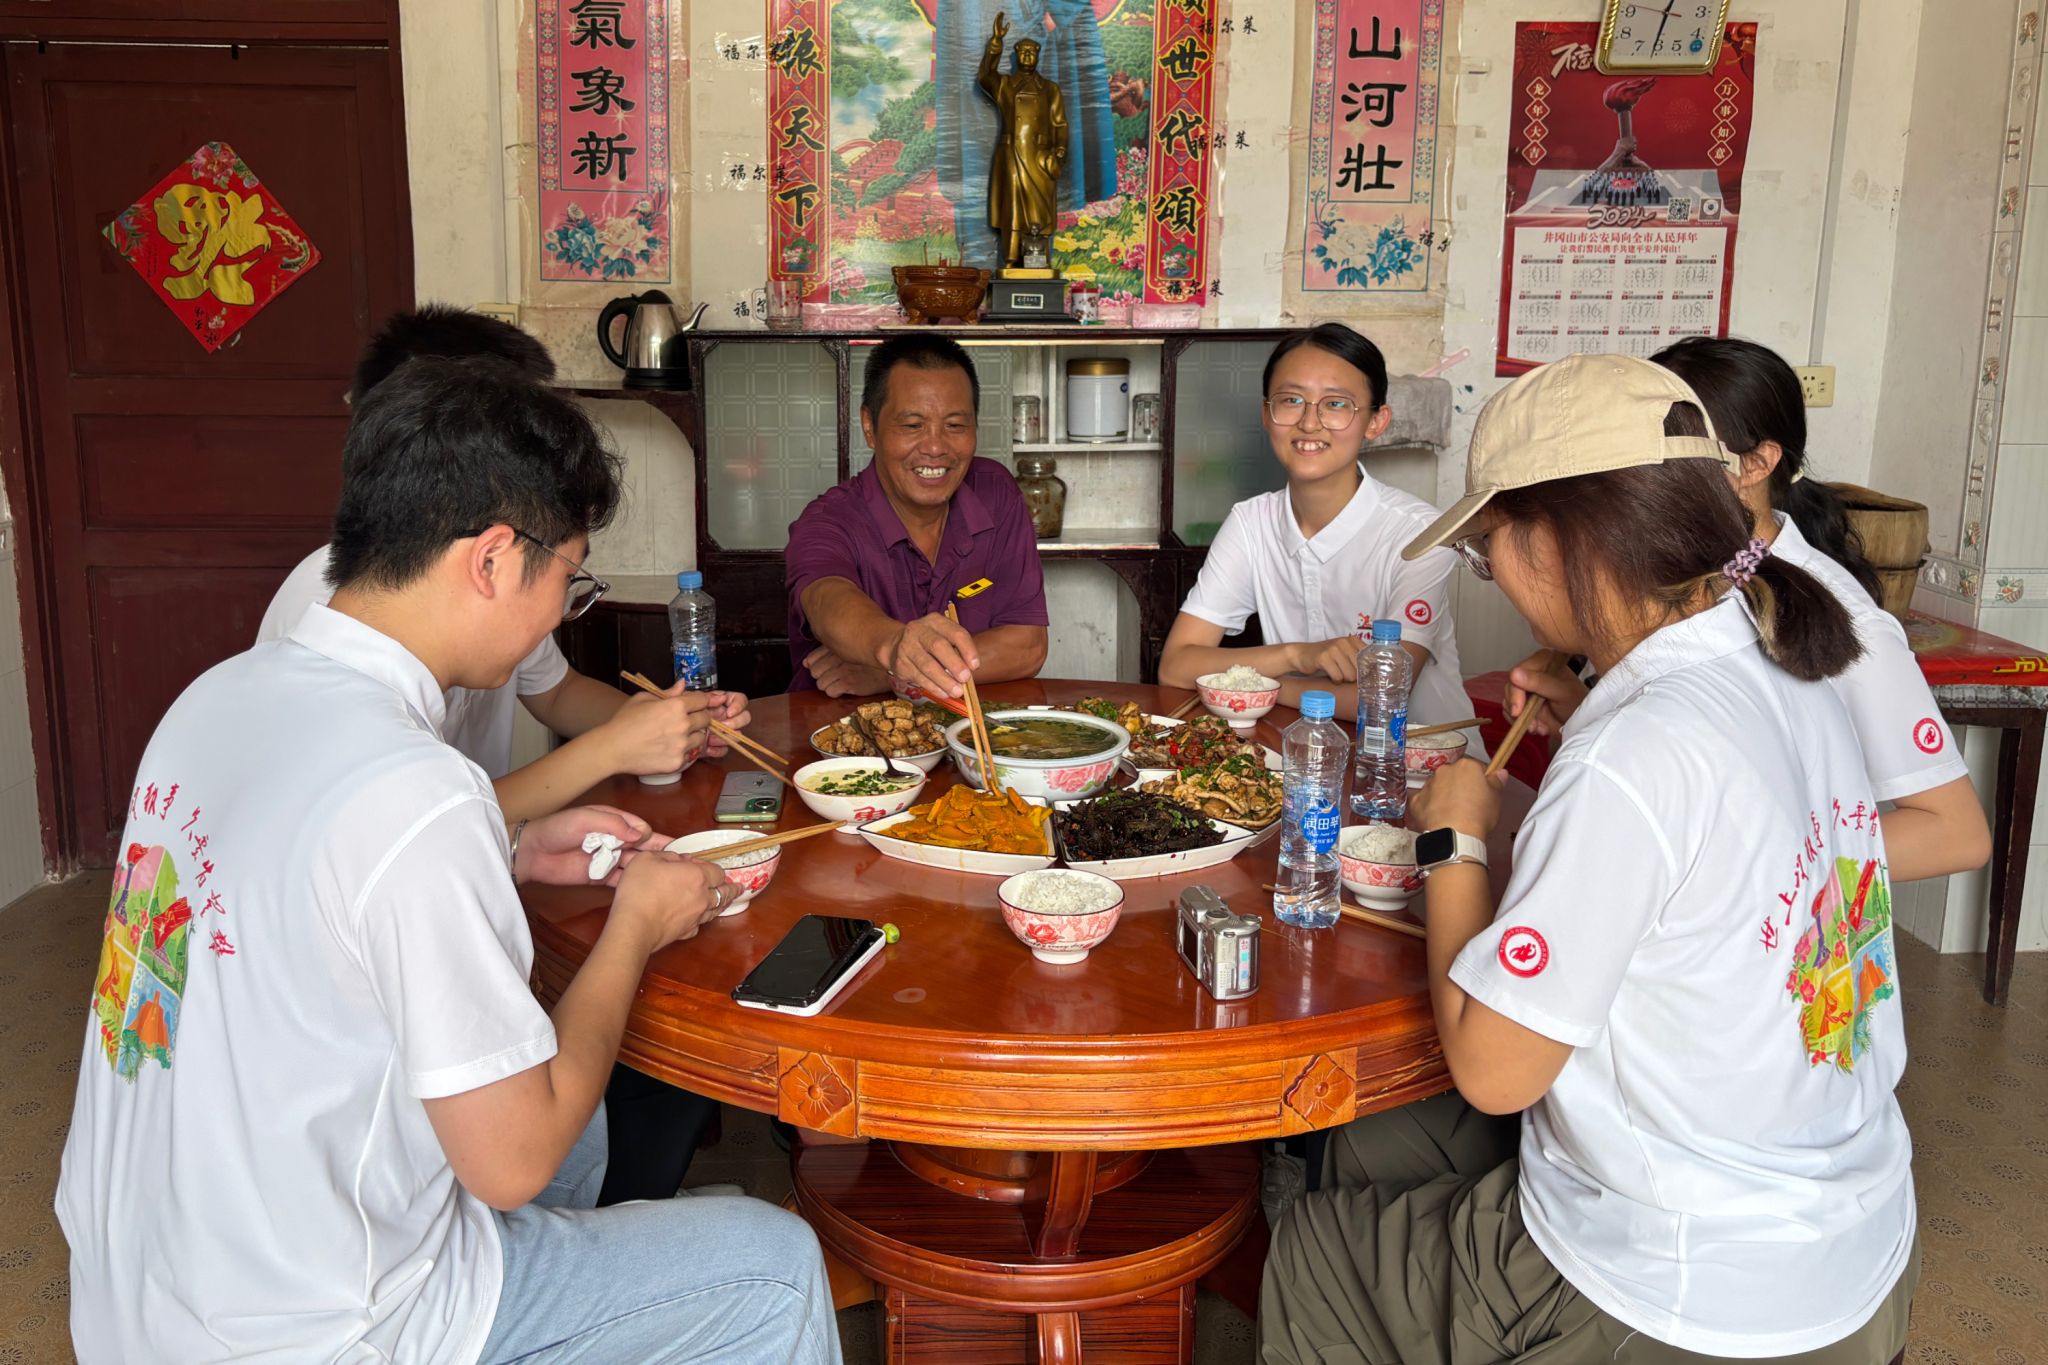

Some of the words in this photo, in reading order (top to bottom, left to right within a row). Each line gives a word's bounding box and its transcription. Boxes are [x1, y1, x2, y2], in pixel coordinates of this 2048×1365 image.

[1625, 5, 1636, 18] 9
[1695, 6, 1706, 18] 3
[1620, 27, 1632, 39] 8
[1634, 40, 1645, 51] 7
[1671, 40, 1682, 51] 5
[1154, 0, 1208, 234] 世代頌
[1527, 82, 1545, 160] 龙年大吉
[1713, 82, 1733, 160] 万事如意
[1587, 202, 1656, 229] 2024
[1544, 231, 1698, 243] 井冈山市公安局向全市人民拜年
